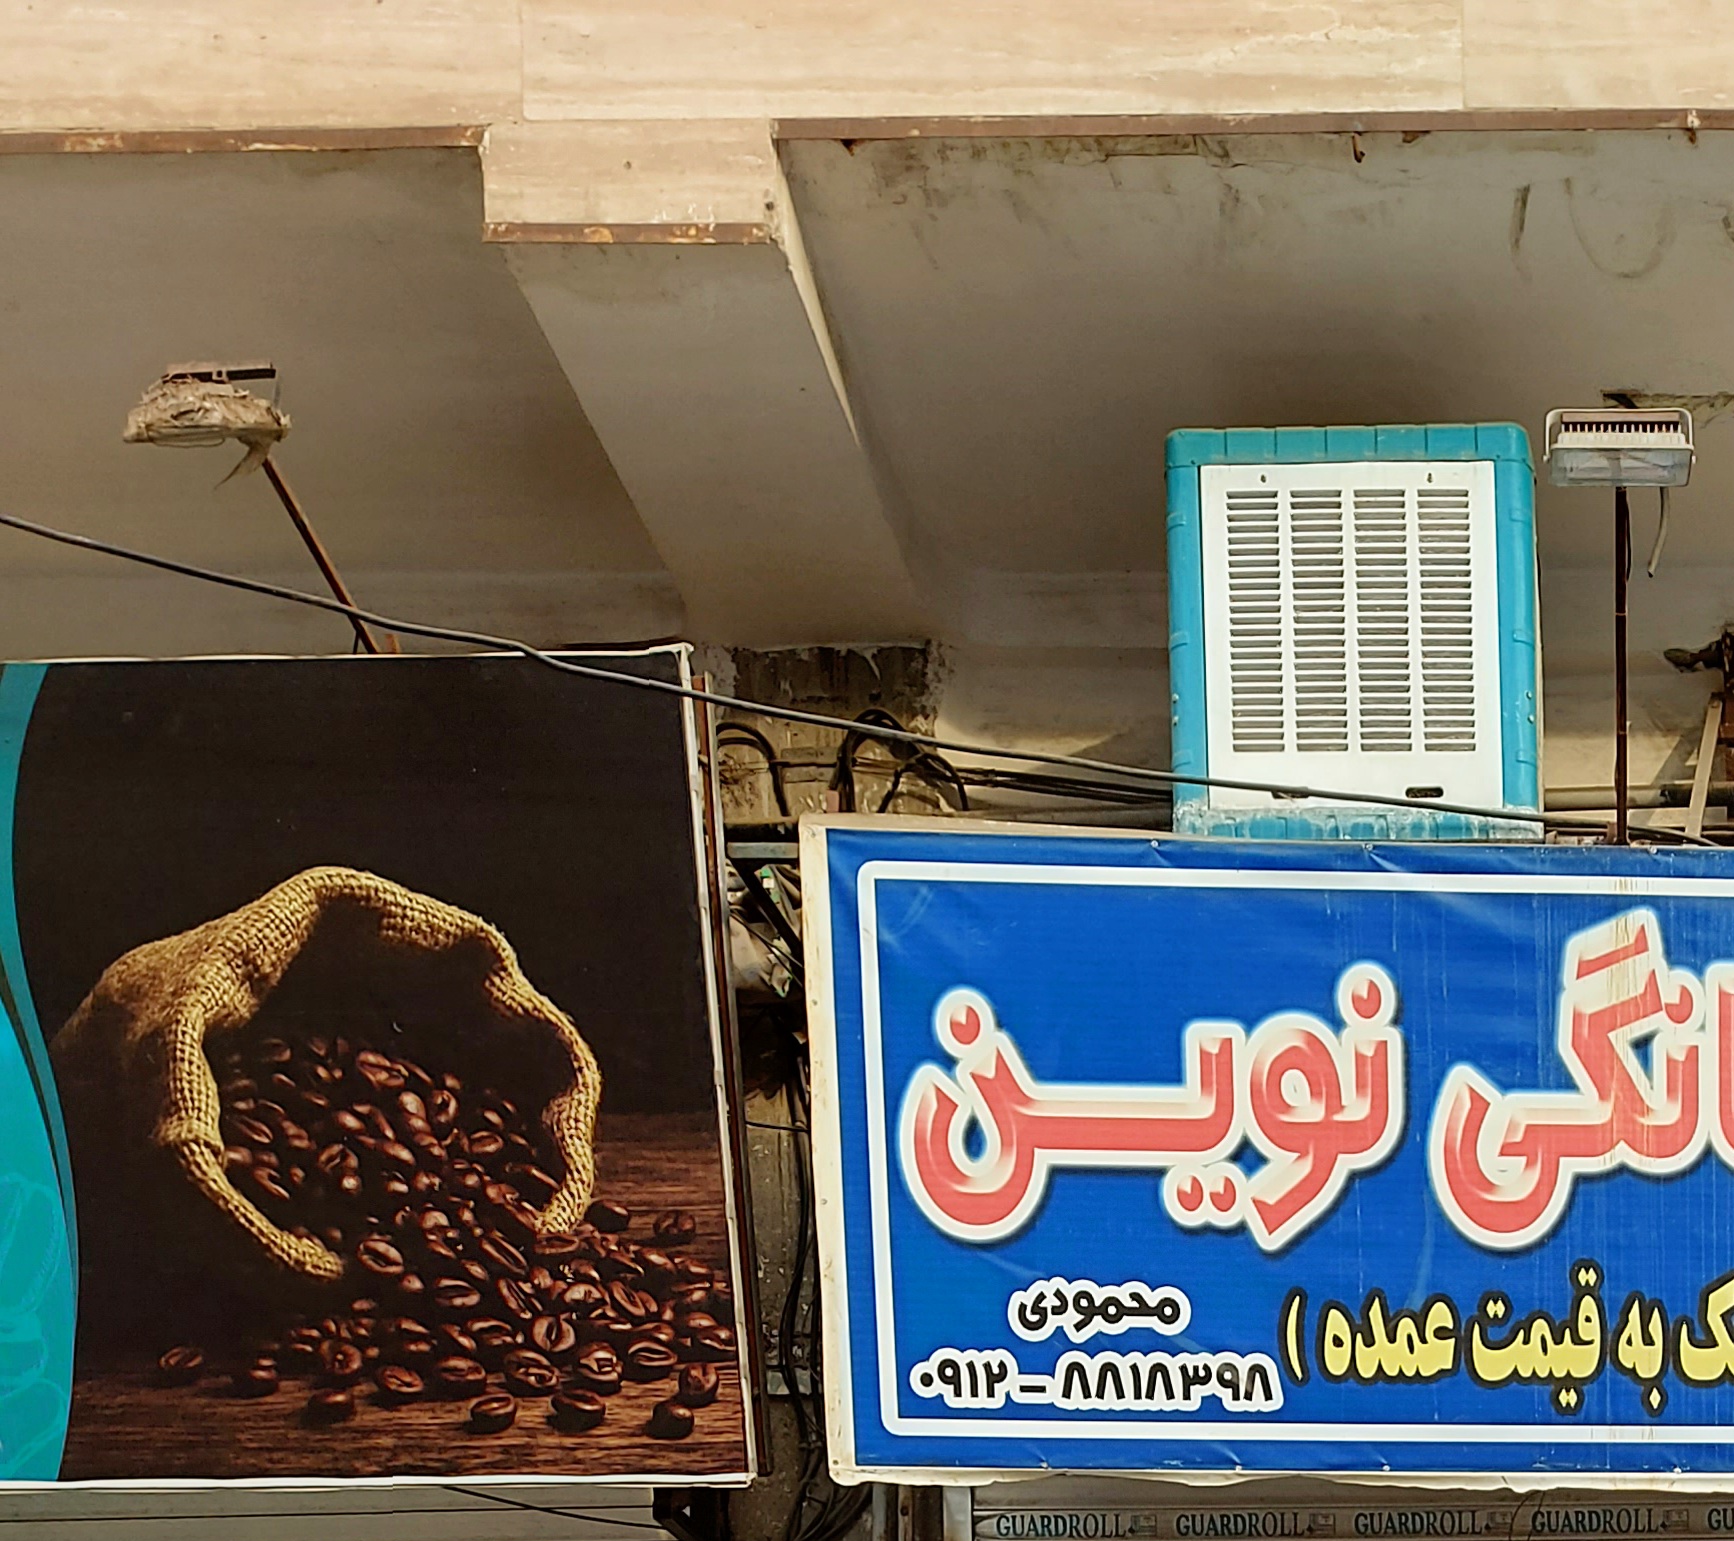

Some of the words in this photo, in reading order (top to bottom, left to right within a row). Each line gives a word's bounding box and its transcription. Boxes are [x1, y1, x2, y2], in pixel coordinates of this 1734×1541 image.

[900, 963, 1403, 1248] نوین
[1014, 1283, 1185, 1337] محمودی
[1470, 1265, 1602, 1409] قیمت
[1616, 1298, 1665, 1411] به
[995, 1513, 1127, 1539] GUARDROLL
[1174, 1512, 1306, 1538] GUARDROLL
[1353, 1511, 1484, 1537] GUARDROLL
[1531, 1510, 1660, 1534] GUARDROLL
